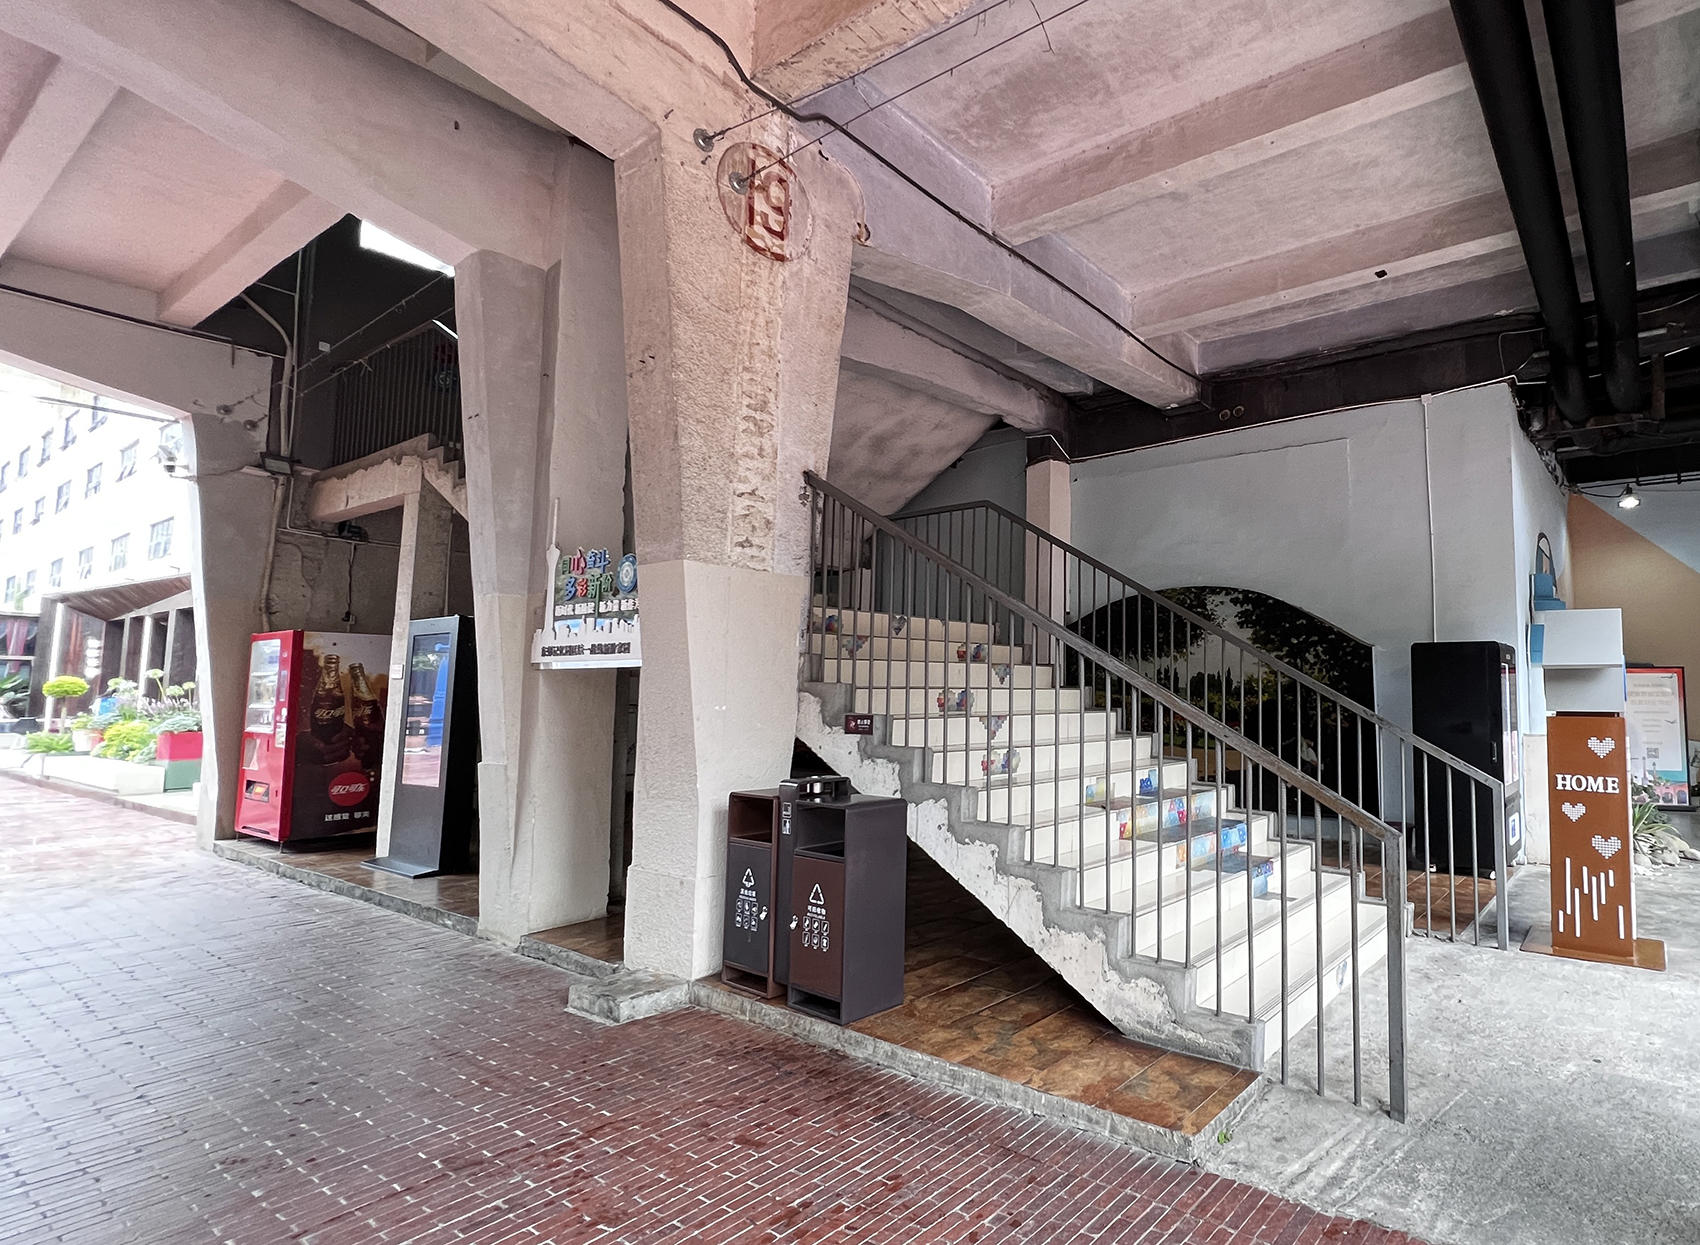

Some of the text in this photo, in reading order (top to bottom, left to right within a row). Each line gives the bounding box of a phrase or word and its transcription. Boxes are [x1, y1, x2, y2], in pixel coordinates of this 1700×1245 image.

[331, 783, 368, 795] 可口可乐
[1555, 774, 1620, 794] HOME
